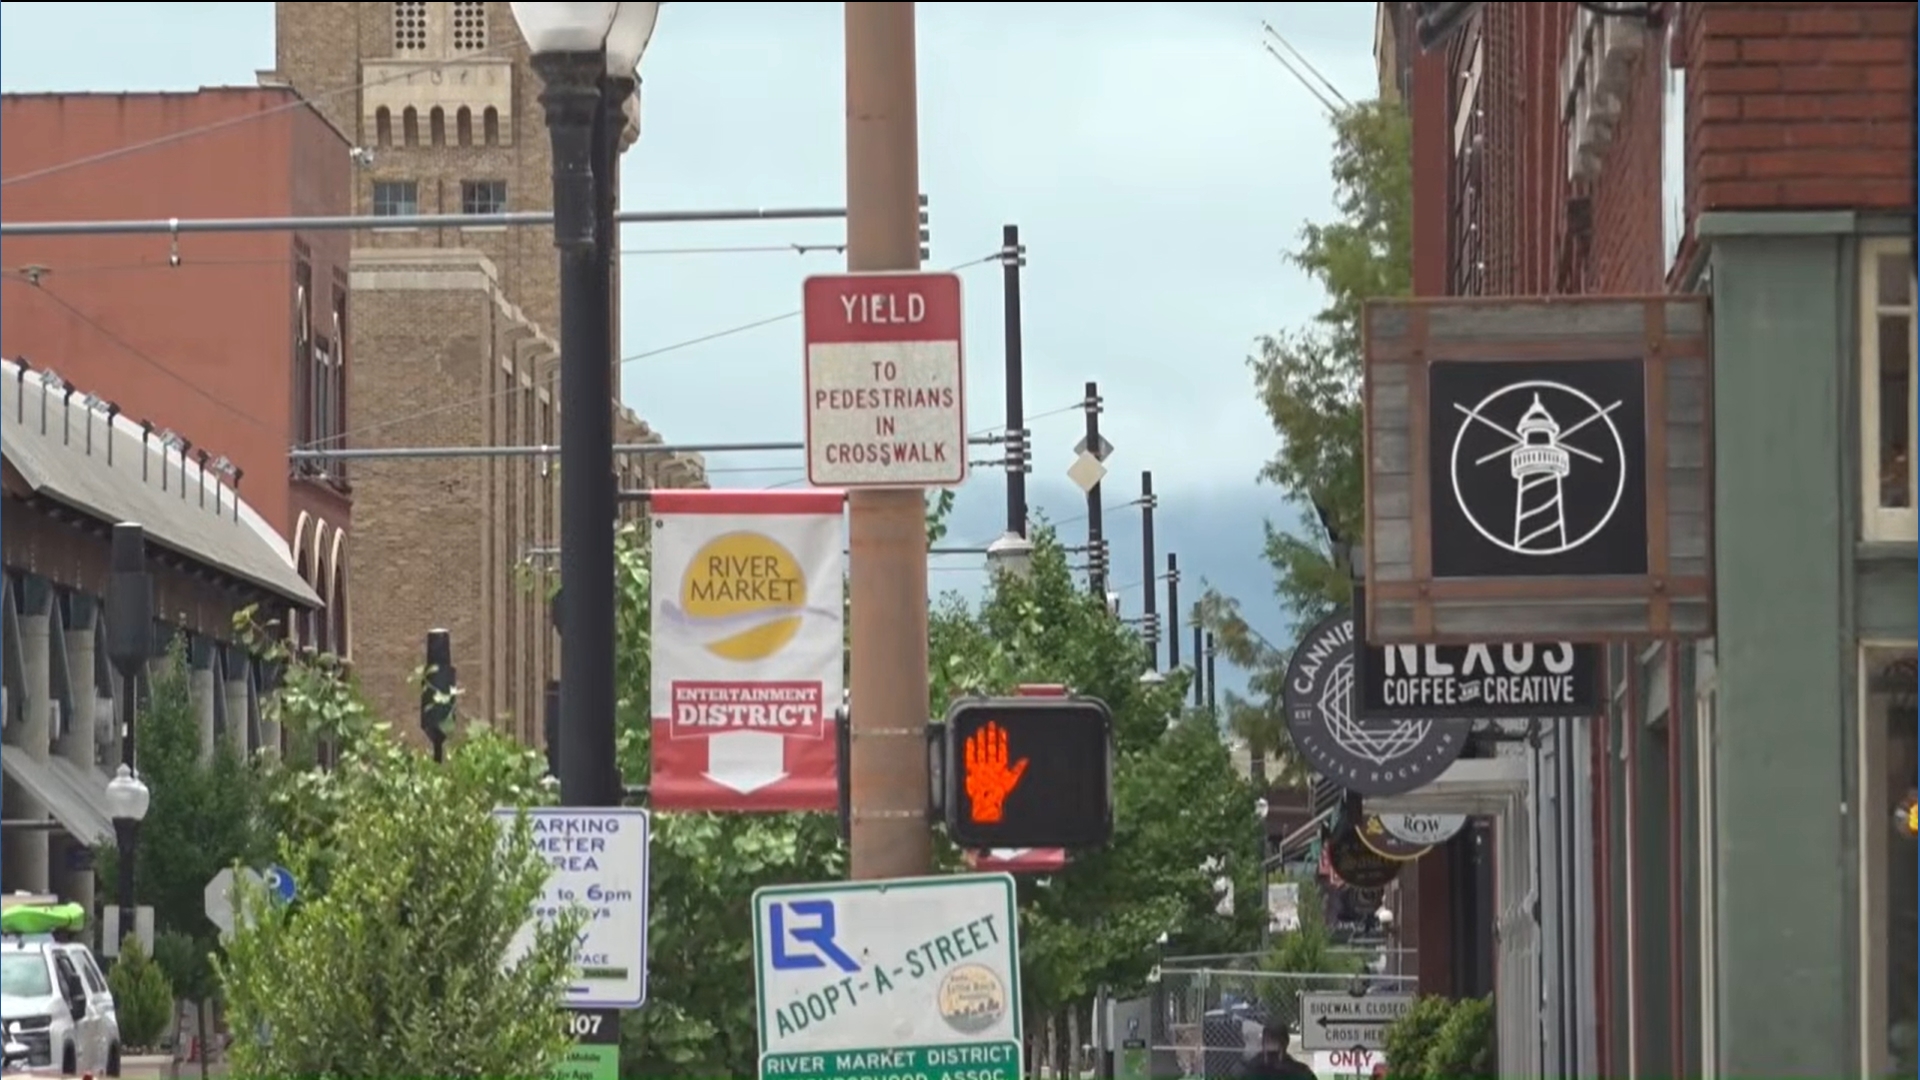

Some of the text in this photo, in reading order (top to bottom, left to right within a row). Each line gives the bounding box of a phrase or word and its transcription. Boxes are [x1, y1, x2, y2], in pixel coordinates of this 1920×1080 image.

[840, 293, 926, 324] YIELD
[872, 361, 896, 381] TO
[815, 387, 954, 410] PEDESTRIANS
[875, 416, 895, 436] IN
[825, 442, 946, 464] CROSSWALK
[708, 556, 781, 578] RIVER
[690, 578, 797, 601] MARKET
[1294, 619, 1354, 695] CANNIB
[675, 687, 818, 702] ENTERTAINMENT
[1383, 677, 1457, 706] COFFEE
[1483, 674, 1575, 704] CREATIVE
[677, 703, 817, 727] DISTRICT
[1294, 709, 1313, 720] EST
[1303, 736, 1357, 779] LITTLE
[1371, 763, 1420, 782] ROCK
[533, 818, 620, 834] ARKING
[1403, 815, 1440, 834] ROW
[529, 837, 606, 853] METER
[557, 888, 575, 901] to
[587, 883, 632, 903] 6pm
[768, 899, 862, 973] LR
[573, 953, 609, 965] PACE
[775, 914, 999, 1039] ADOPT-A-STREET
[1310, 1002, 1407, 1015] SIDEWALK CLOSED
[569, 1014, 603, 1035] 107
[1325, 1028, 1386, 1040] CROSS HER
[766, 1045, 1013, 1074] RIVER MARKET DISTRICT
